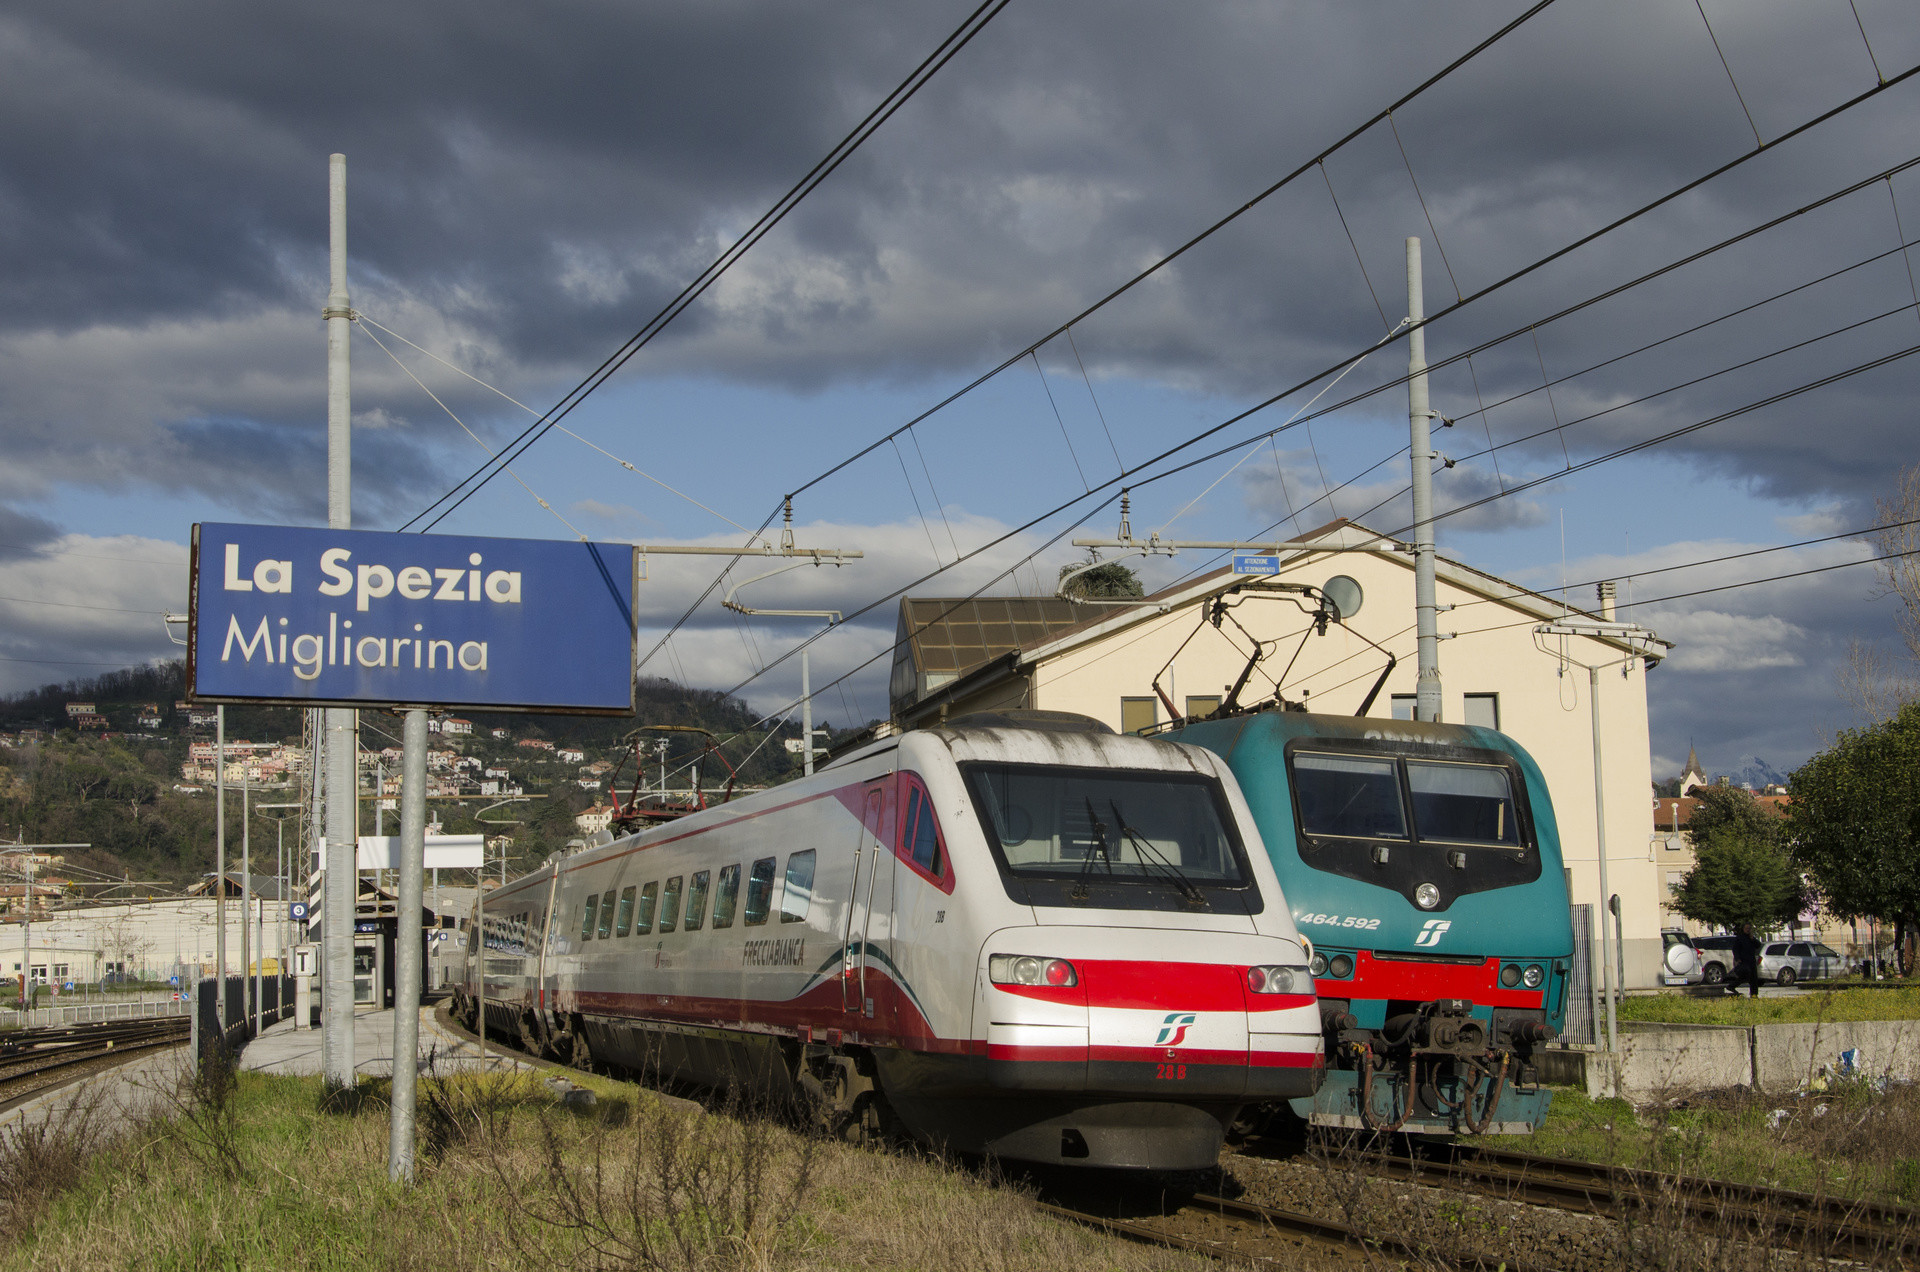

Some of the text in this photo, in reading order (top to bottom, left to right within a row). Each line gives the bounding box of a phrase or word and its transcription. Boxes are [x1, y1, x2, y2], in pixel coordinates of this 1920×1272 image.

[1244, 557, 1268, 565] ATTENZIONE
[224, 543, 522, 612] La Spezia
[221, 612, 489, 680] Migliarina
[1300, 912, 1381, 931] 464.592
[297, 952, 308, 972] T
[743, 938, 805, 966] FRECCIABIANCA
